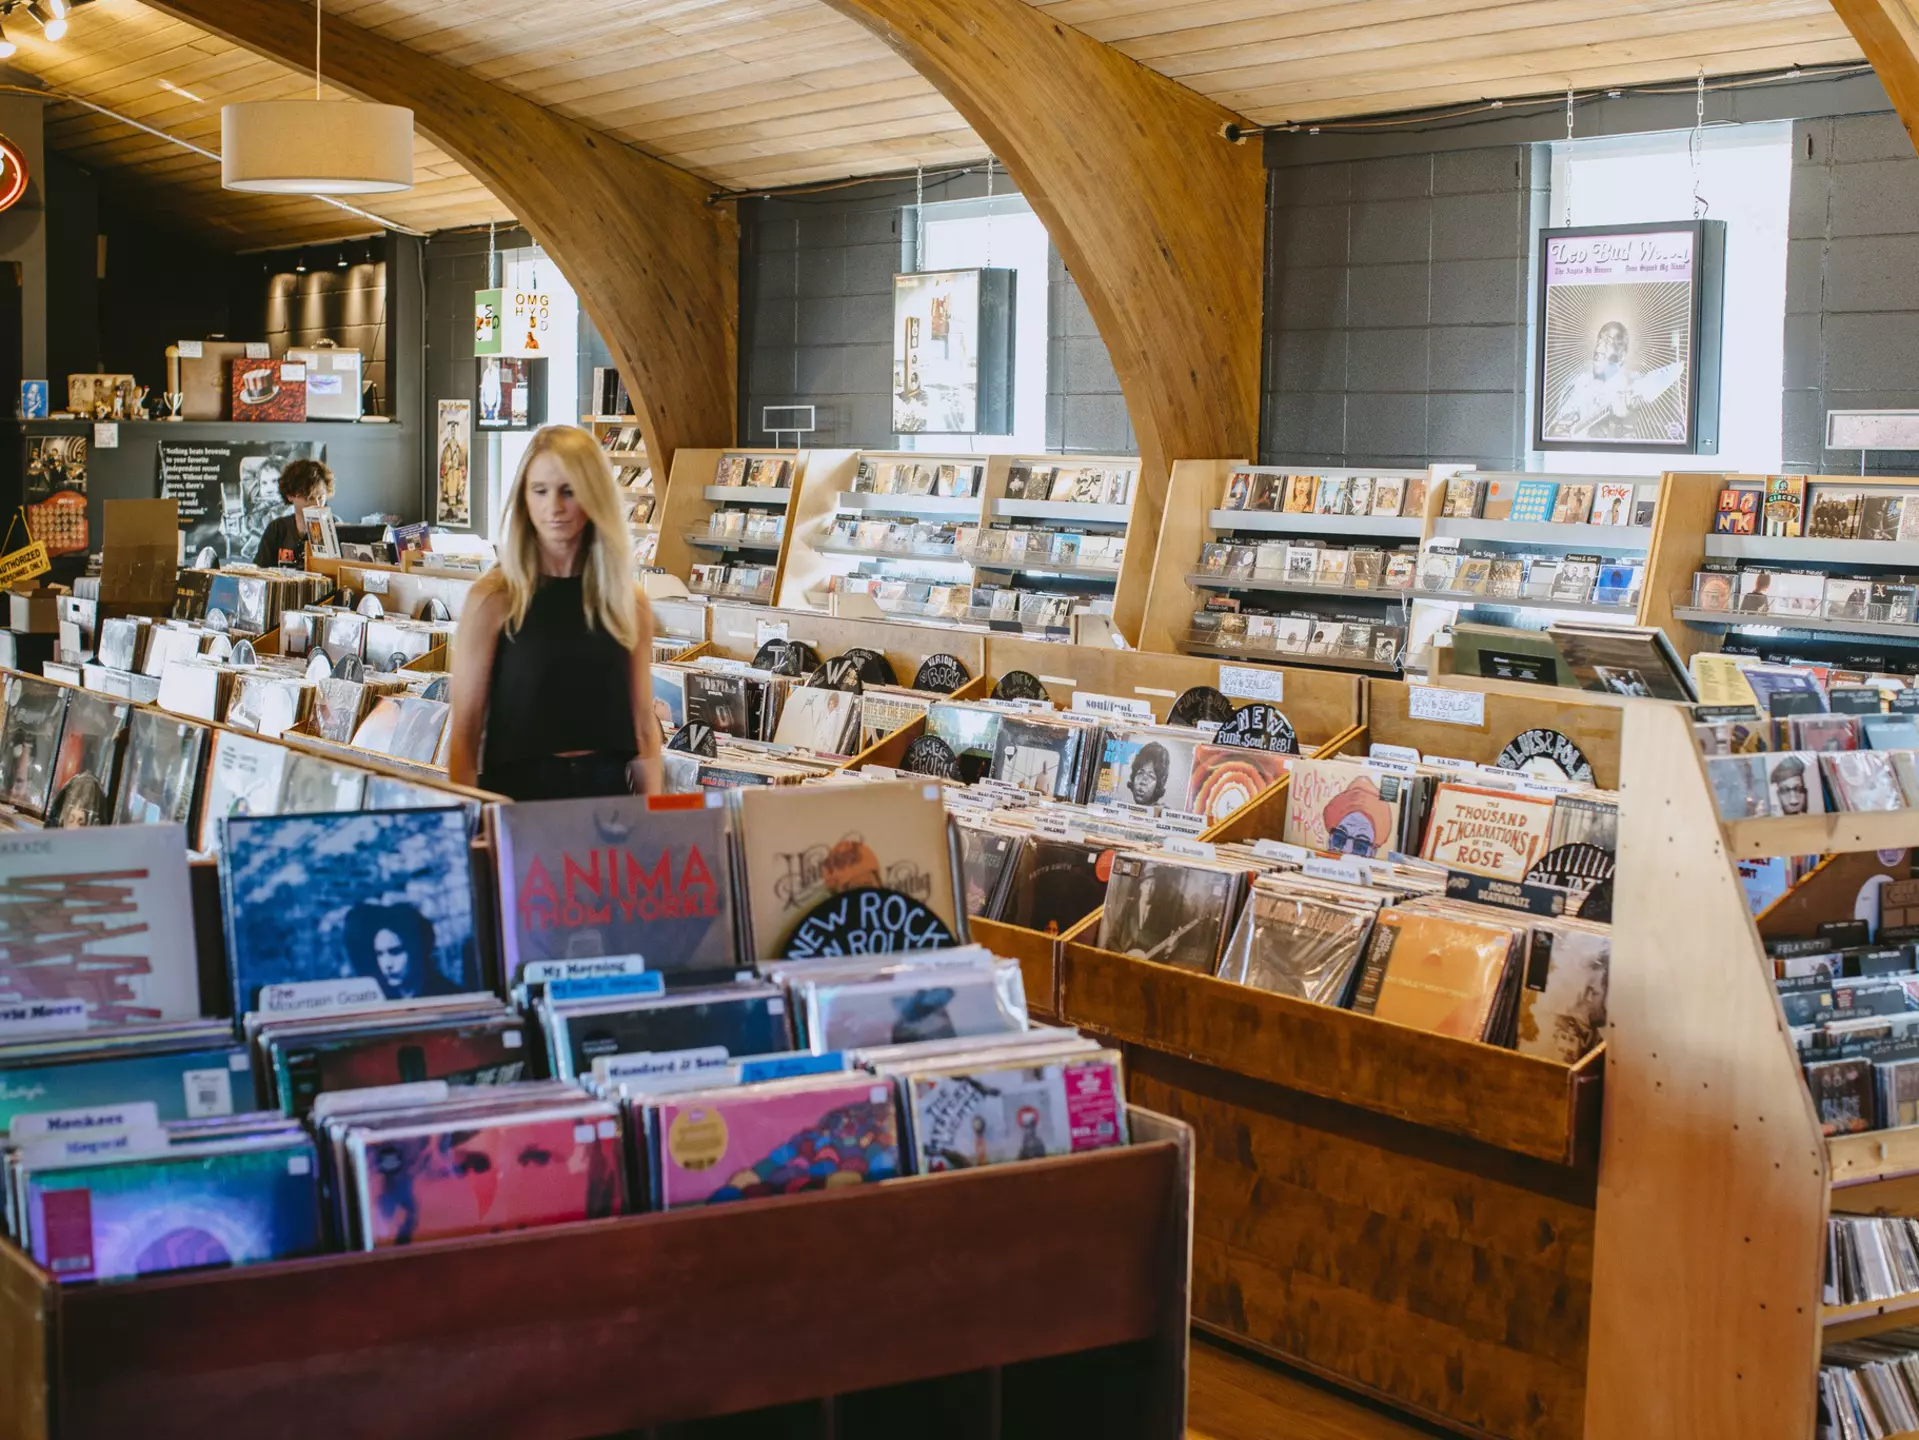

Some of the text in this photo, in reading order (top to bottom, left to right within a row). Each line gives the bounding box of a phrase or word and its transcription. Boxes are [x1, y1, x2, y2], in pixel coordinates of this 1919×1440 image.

[826, 660, 851, 685] W
[927, 655, 957, 670] VARIOUS
[1237, 706, 1284, 736] NEW
[689, 724, 711, 751] V
[1455, 804, 1528, 827] THOUSAND
[1441, 819, 1529, 856] INCARNATIONS
[1456, 845, 1504, 869] ROSE
[519, 843, 718, 910] ANIMA
[521, 889, 720, 932] THOM YORKE
[788, 892, 950, 960] NEW ROCK
[337, 990, 378, 1005] Goats
